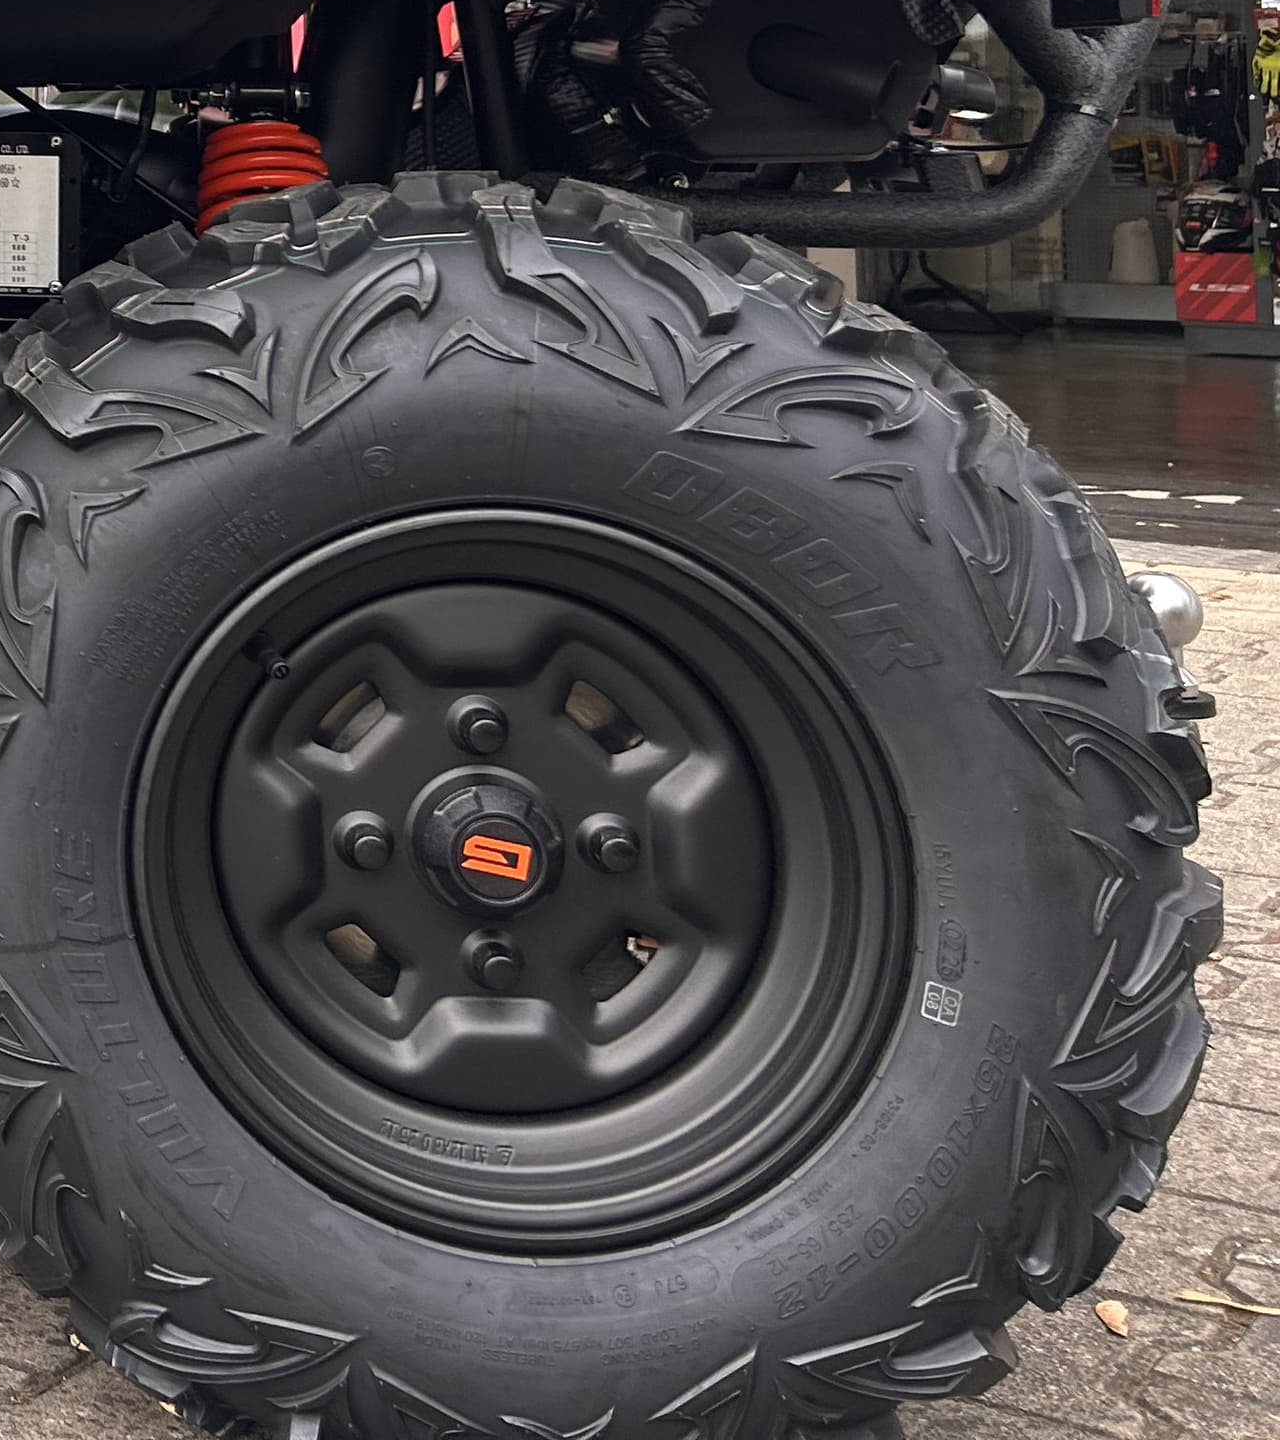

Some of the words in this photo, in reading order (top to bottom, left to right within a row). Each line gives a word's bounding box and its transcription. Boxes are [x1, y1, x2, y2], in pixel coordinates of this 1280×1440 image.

[12, 234, 30, 242] T-3
[629, 449, 942, 683] OBOR
[58, 823, 246, 1225] VULTURE
